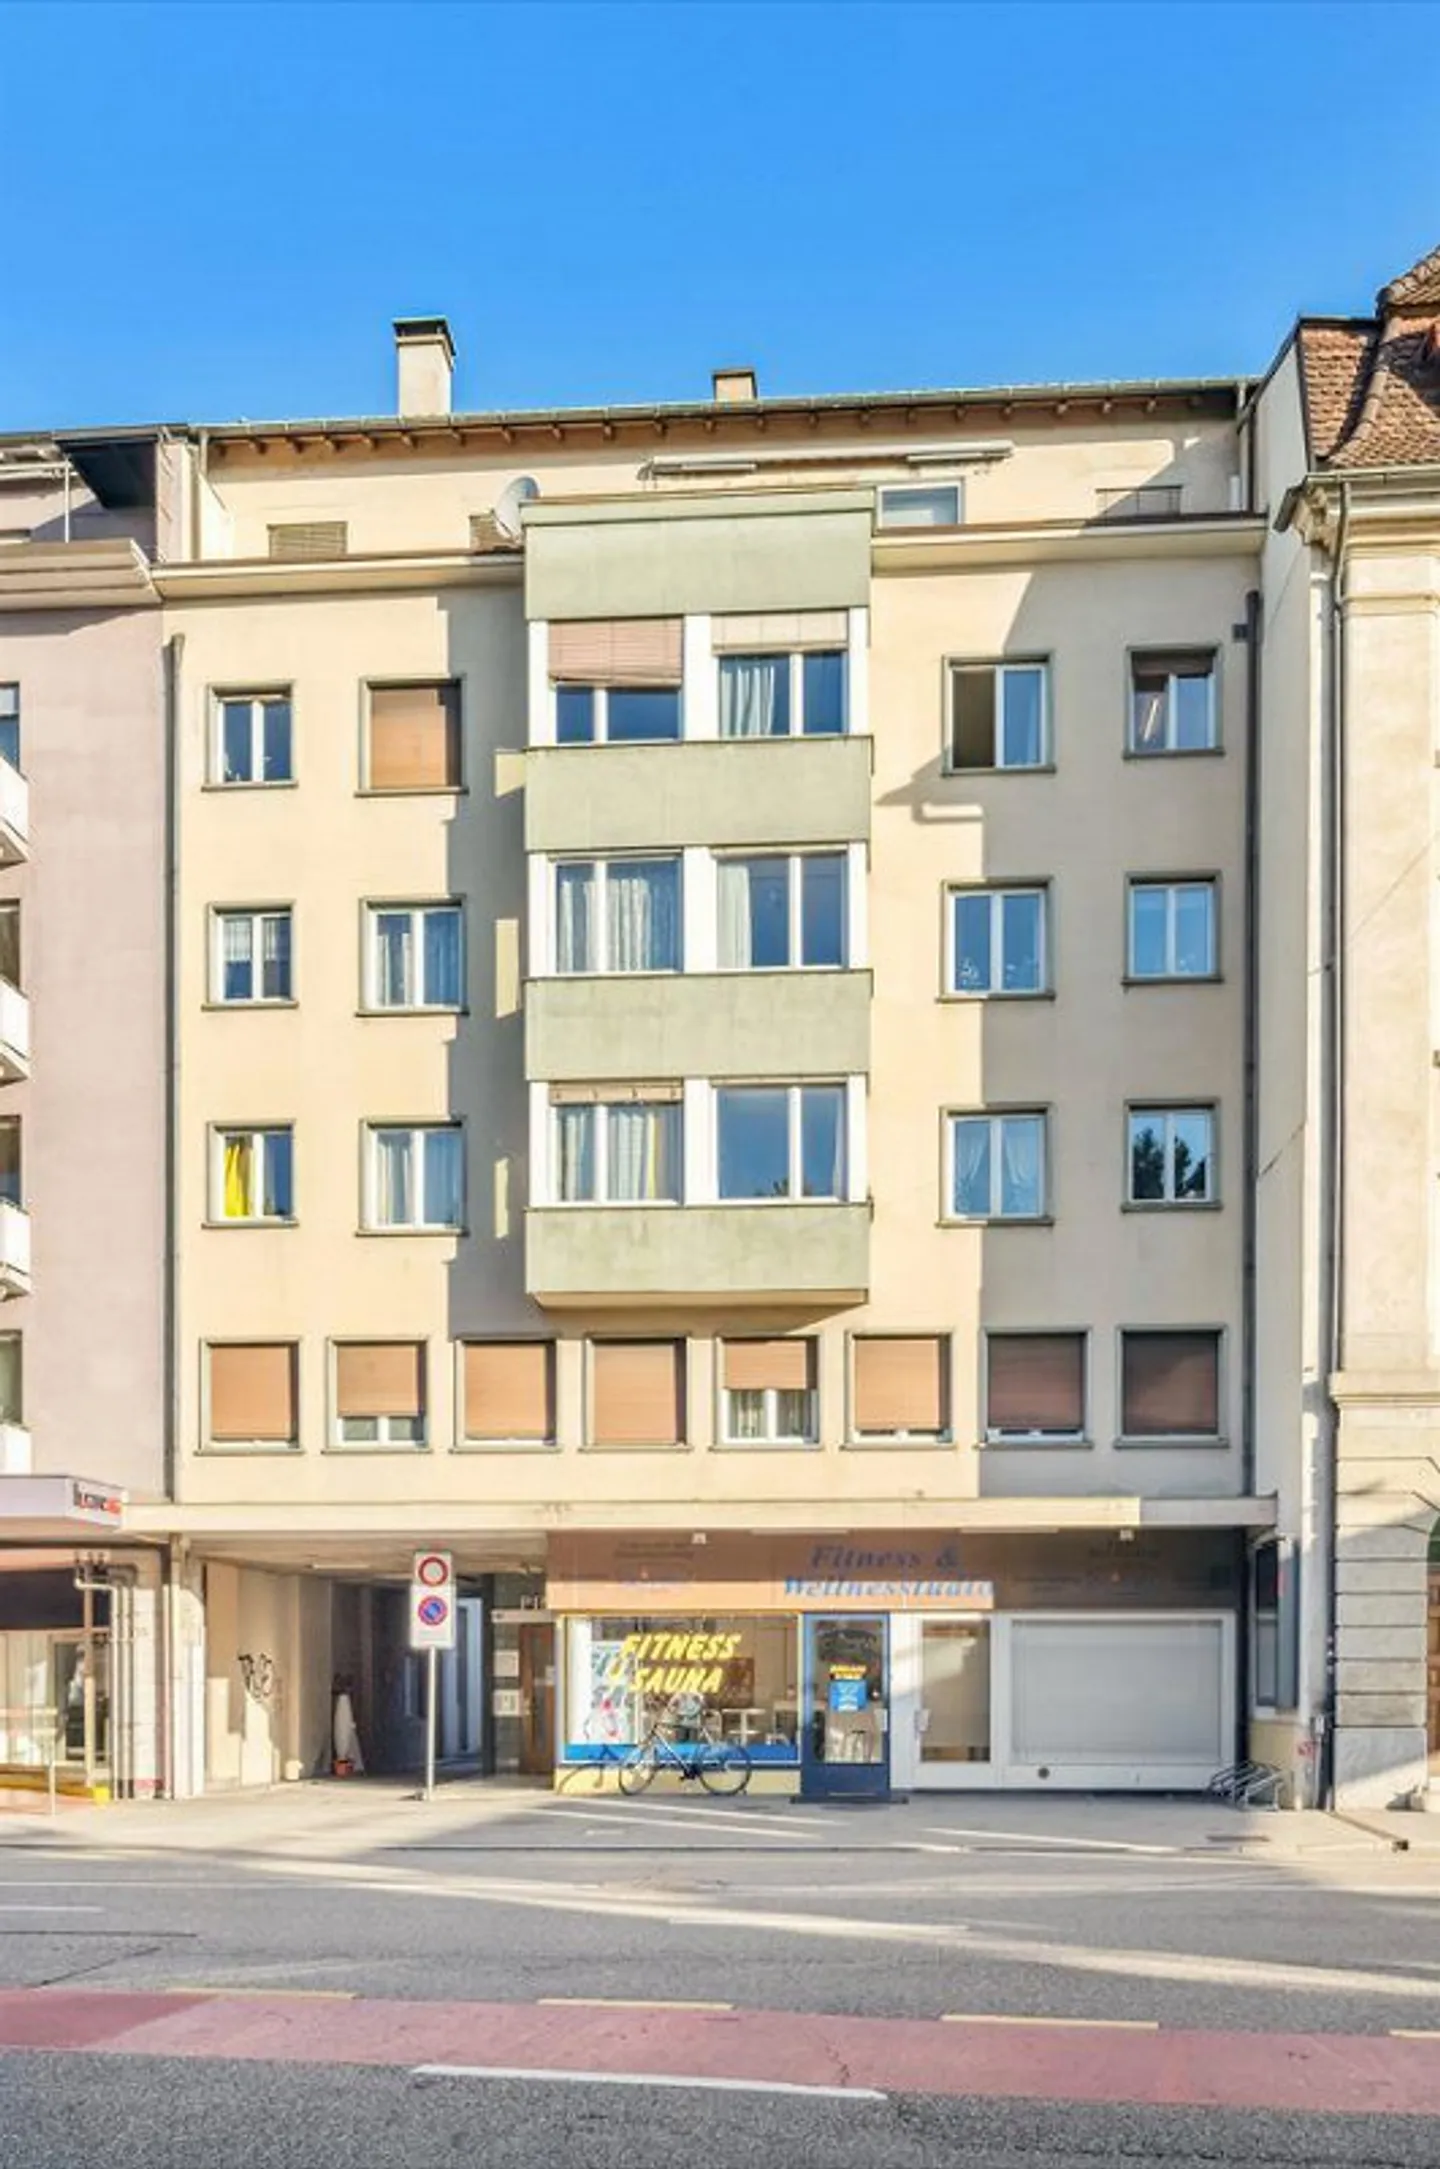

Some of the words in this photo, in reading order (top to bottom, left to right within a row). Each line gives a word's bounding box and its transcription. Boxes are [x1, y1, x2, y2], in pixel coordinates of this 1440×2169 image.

[811, 1546, 921, 1568] Fitness
[935, 1546, 959, 1570] &
[620, 1633, 741, 1660] FITNESS
[629, 1666, 723, 1693] SAUNA
